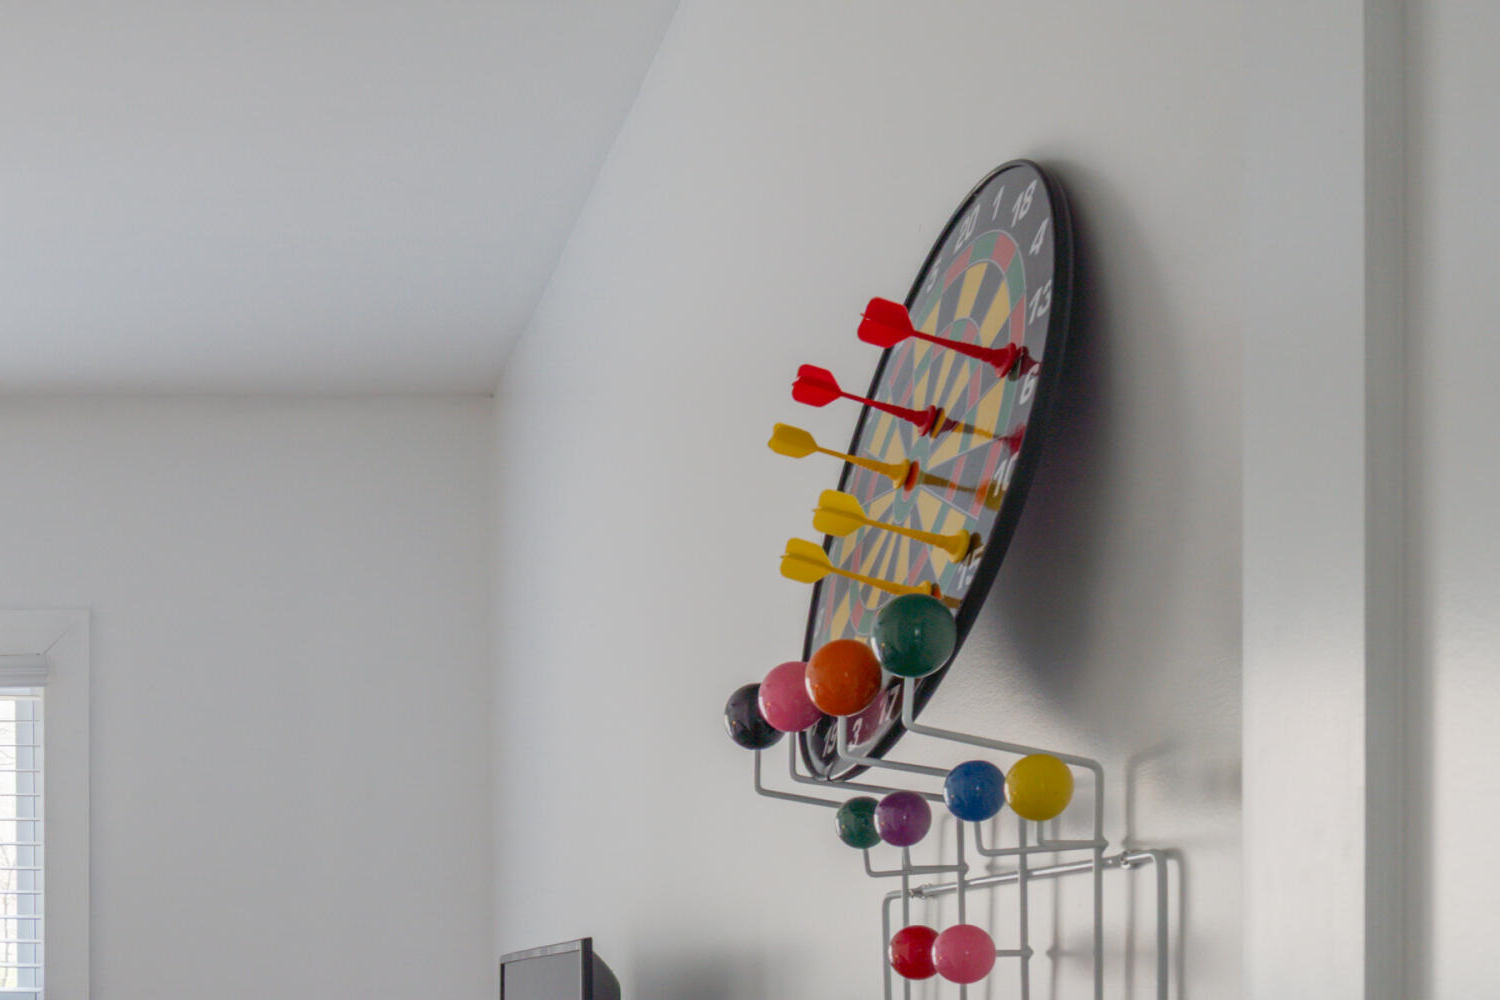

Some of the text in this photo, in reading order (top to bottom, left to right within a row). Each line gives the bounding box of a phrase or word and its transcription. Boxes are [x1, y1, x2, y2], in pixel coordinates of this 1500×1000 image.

[992, 185, 1005, 221] 1
[1011, 179, 1037, 228] 18
[954, 203, 980, 253] 20
[1028, 218, 1048, 256] 4
[1028, 279, 1052, 326] 13
[1019, 363, 1040, 405] 6
